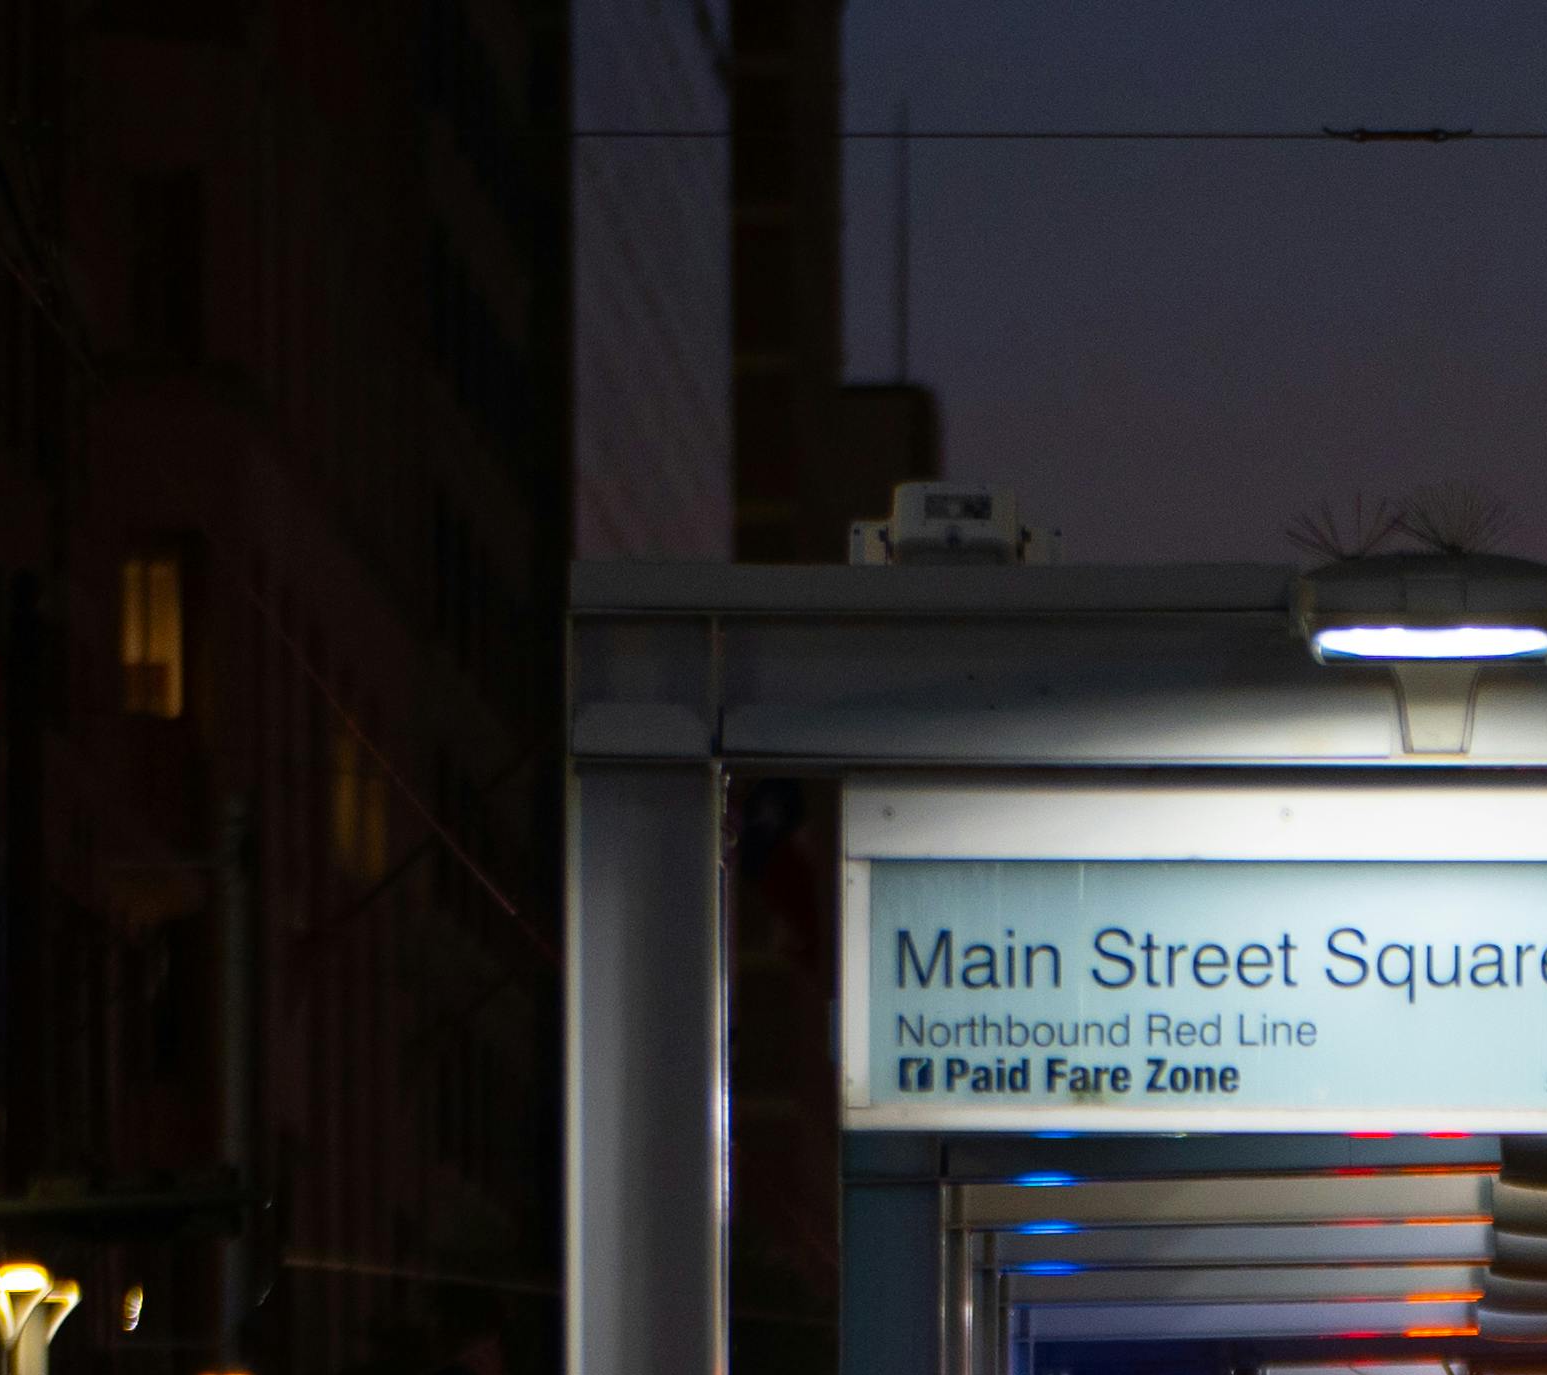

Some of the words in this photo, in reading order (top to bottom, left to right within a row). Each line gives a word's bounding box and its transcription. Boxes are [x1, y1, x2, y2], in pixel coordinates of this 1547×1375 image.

[897, 928, 1062, 989] Main
[1091, 926, 1299, 989] Street
[897, 1013, 1132, 1048] Northbound
[1147, 1013, 1223, 1048] Red
[1238, 1013, 1318, 1048] Line
[945, 1056, 1031, 1093] Paid
[1046, 1057, 1132, 1093] Fare
[1145, 1057, 1241, 1093] Zone
